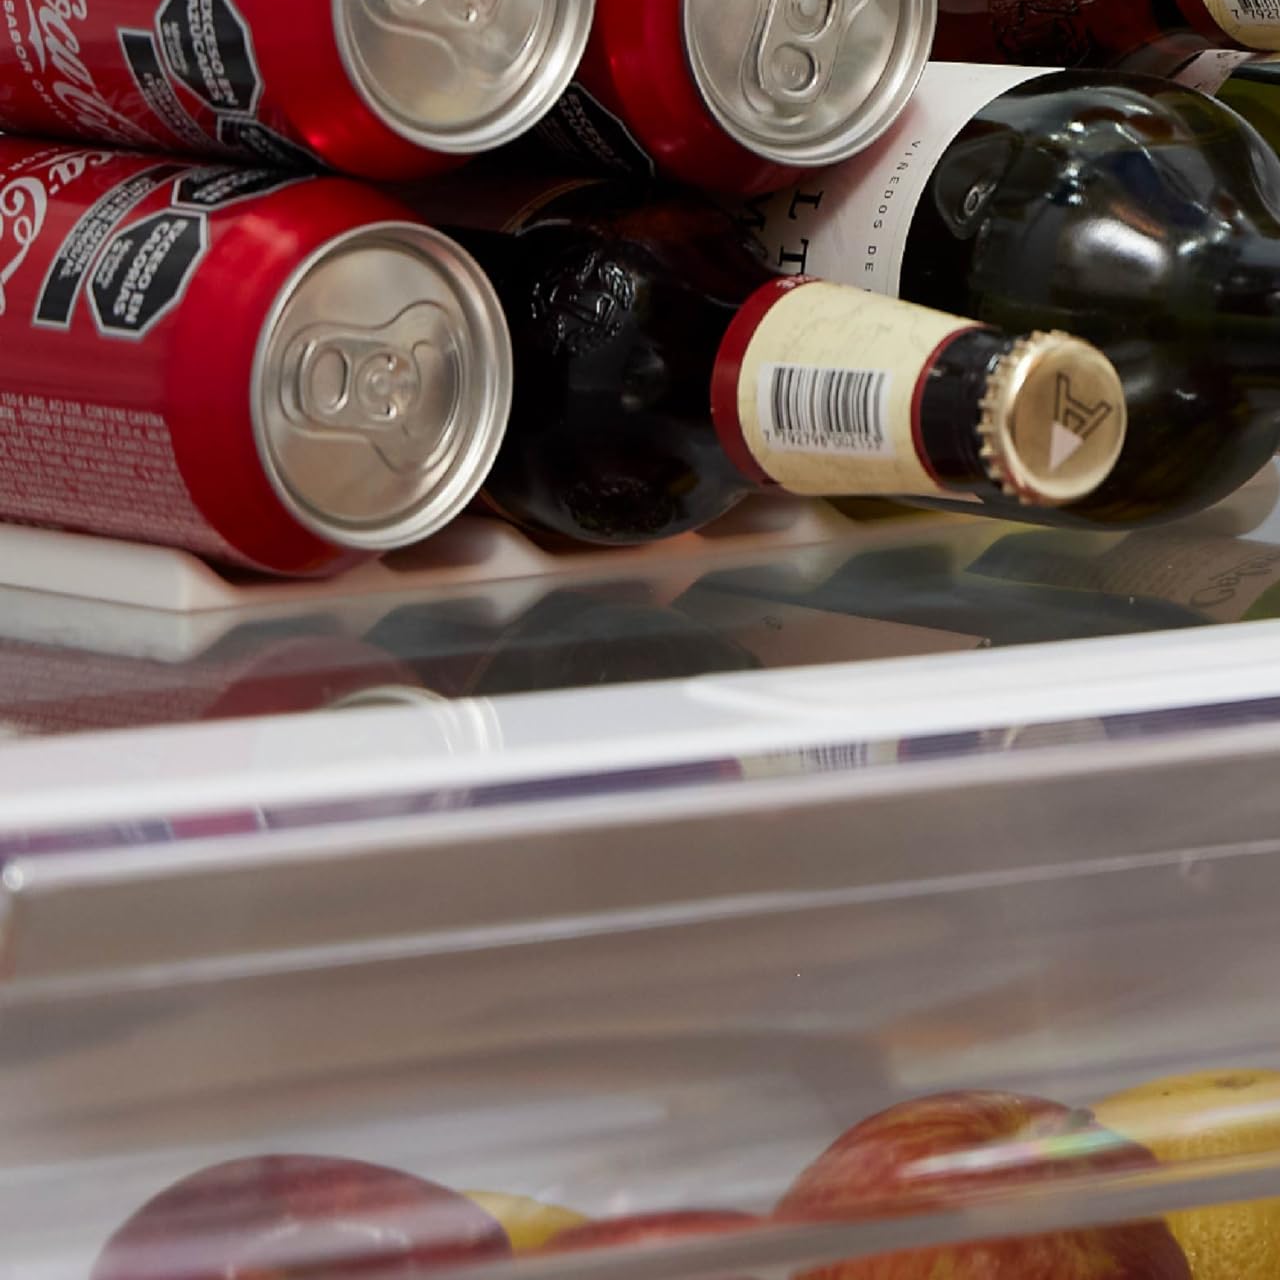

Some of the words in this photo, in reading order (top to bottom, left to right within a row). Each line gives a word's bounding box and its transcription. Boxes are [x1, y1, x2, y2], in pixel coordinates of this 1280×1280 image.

[4, 0, 33, 73] SABOR
[218, 78, 239, 106] EN
[873, 140, 921, 229] VIÑEDOS
[113, 221, 170, 315] CALORÍAS
[138, 220, 189, 290] EXCESO
[864, 245, 877, 272] DE
[125, 292, 144, 324] EN
